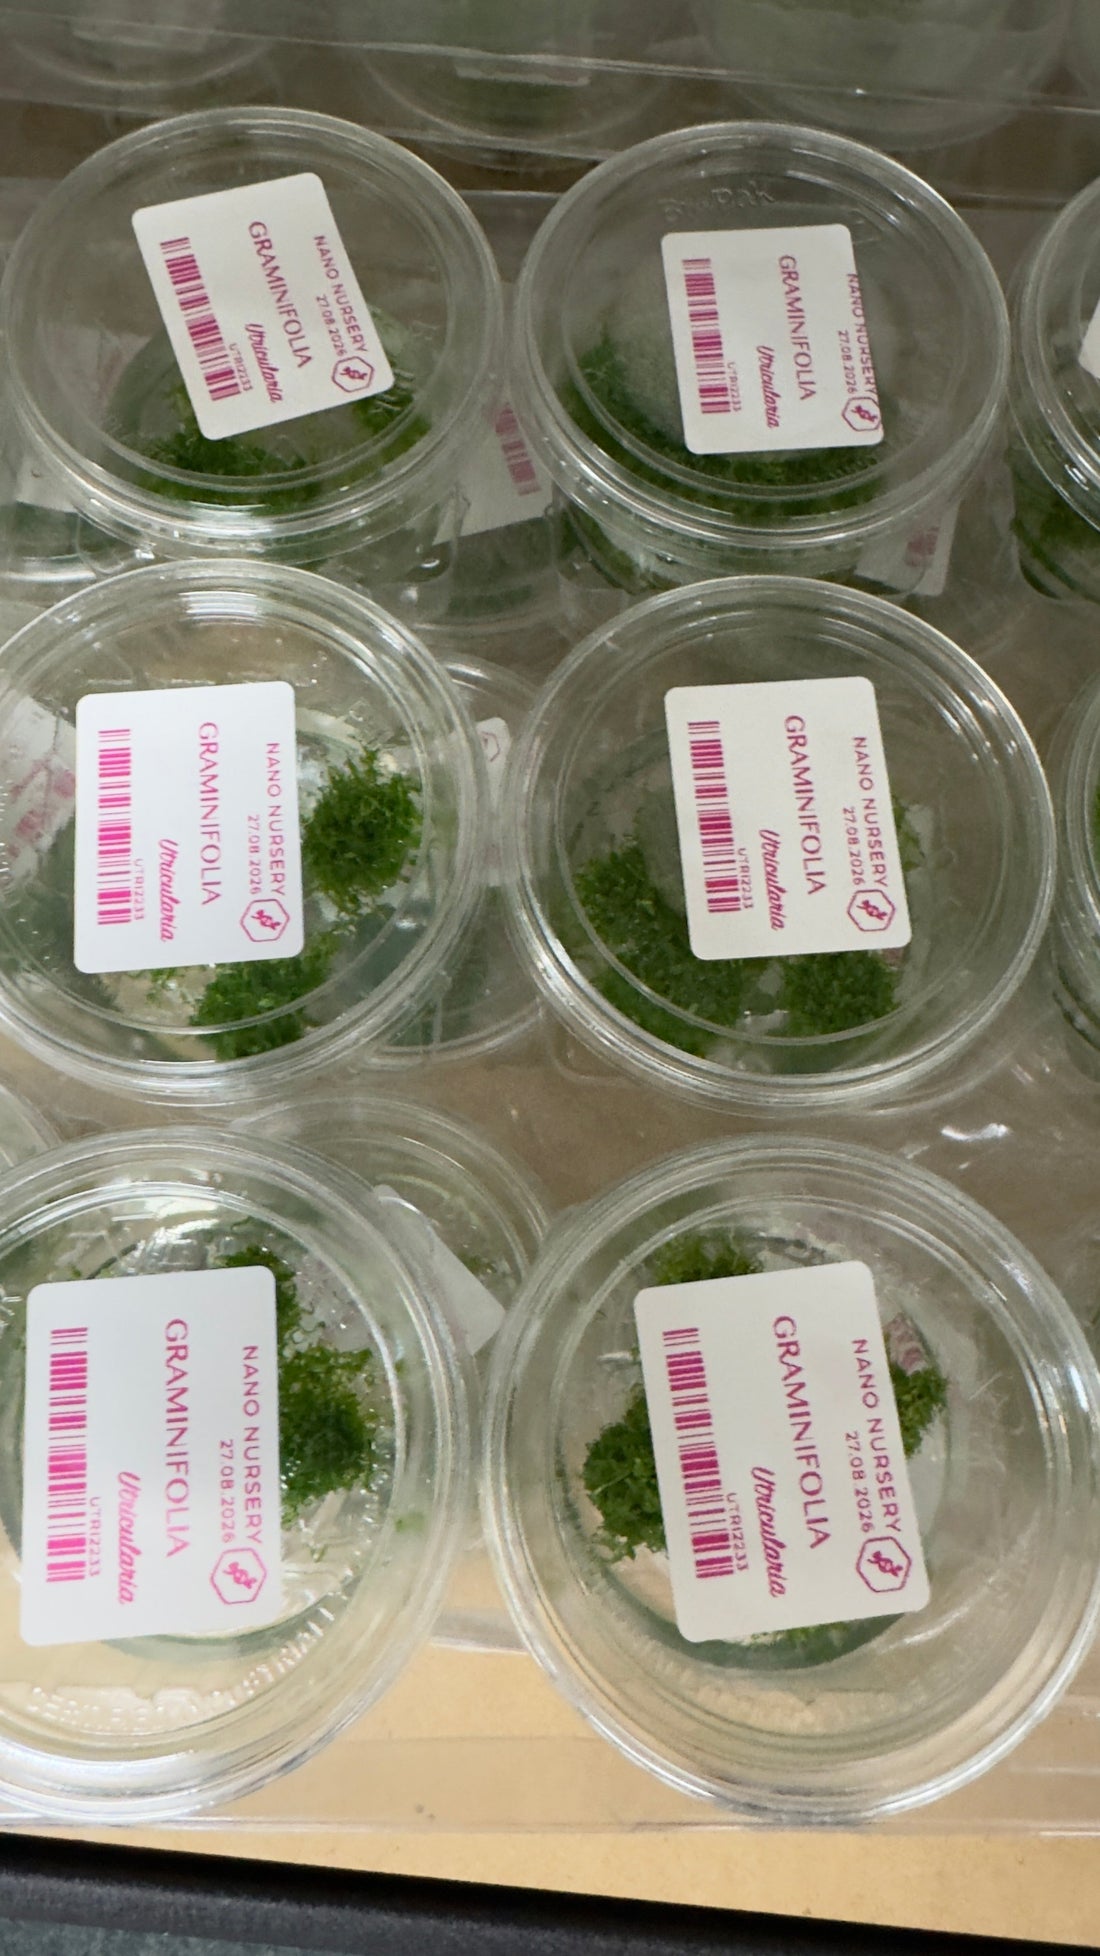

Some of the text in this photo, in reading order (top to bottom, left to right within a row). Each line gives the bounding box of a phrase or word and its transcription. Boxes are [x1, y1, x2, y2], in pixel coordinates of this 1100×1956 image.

[248, 221, 313, 368] GRAMINIFOLIA
[314, 235, 368, 357] NANO NURSERY
[315, 294, 348, 361] 27.08.2026
[778, 254, 816, 400] GRAMINIFOLIA
[244, 323, 283, 404] Utricularia
[756, 345, 781, 429] Utricularia
[837, 330, 858, 394] 27.08.2026
[199, 722, 223, 906] GRAMINIFOLIA
[248, 815, 262, 895] 27.08.2026
[266, 743, 286, 898] NANO NURSERY
[784, 715, 827, 895] GRAMINIFOLIA
[842, 806, 866, 886] 27.08.2026
[852, 737, 888, 888] NANO NURSERY
[158, 839, 181, 943] Utricularia
[758, 829, 787, 931] Utricularia
[164, 1318, 190, 1557] GRAMINIFOLIA
[219, 1439, 235, 1543] 27.08.2026
[242, 1345, 262, 1543] NANO NURSERY
[772, 1315, 832, 1549] GRAMINIFOLIA
[845, 1431, 875, 1534] 27.08.2026
[851, 1339, 902, 1532] NANO NURSERY
[116, 1471, 143, 1605] Utricularia
[750, 1466, 788, 1598] Utricularia
